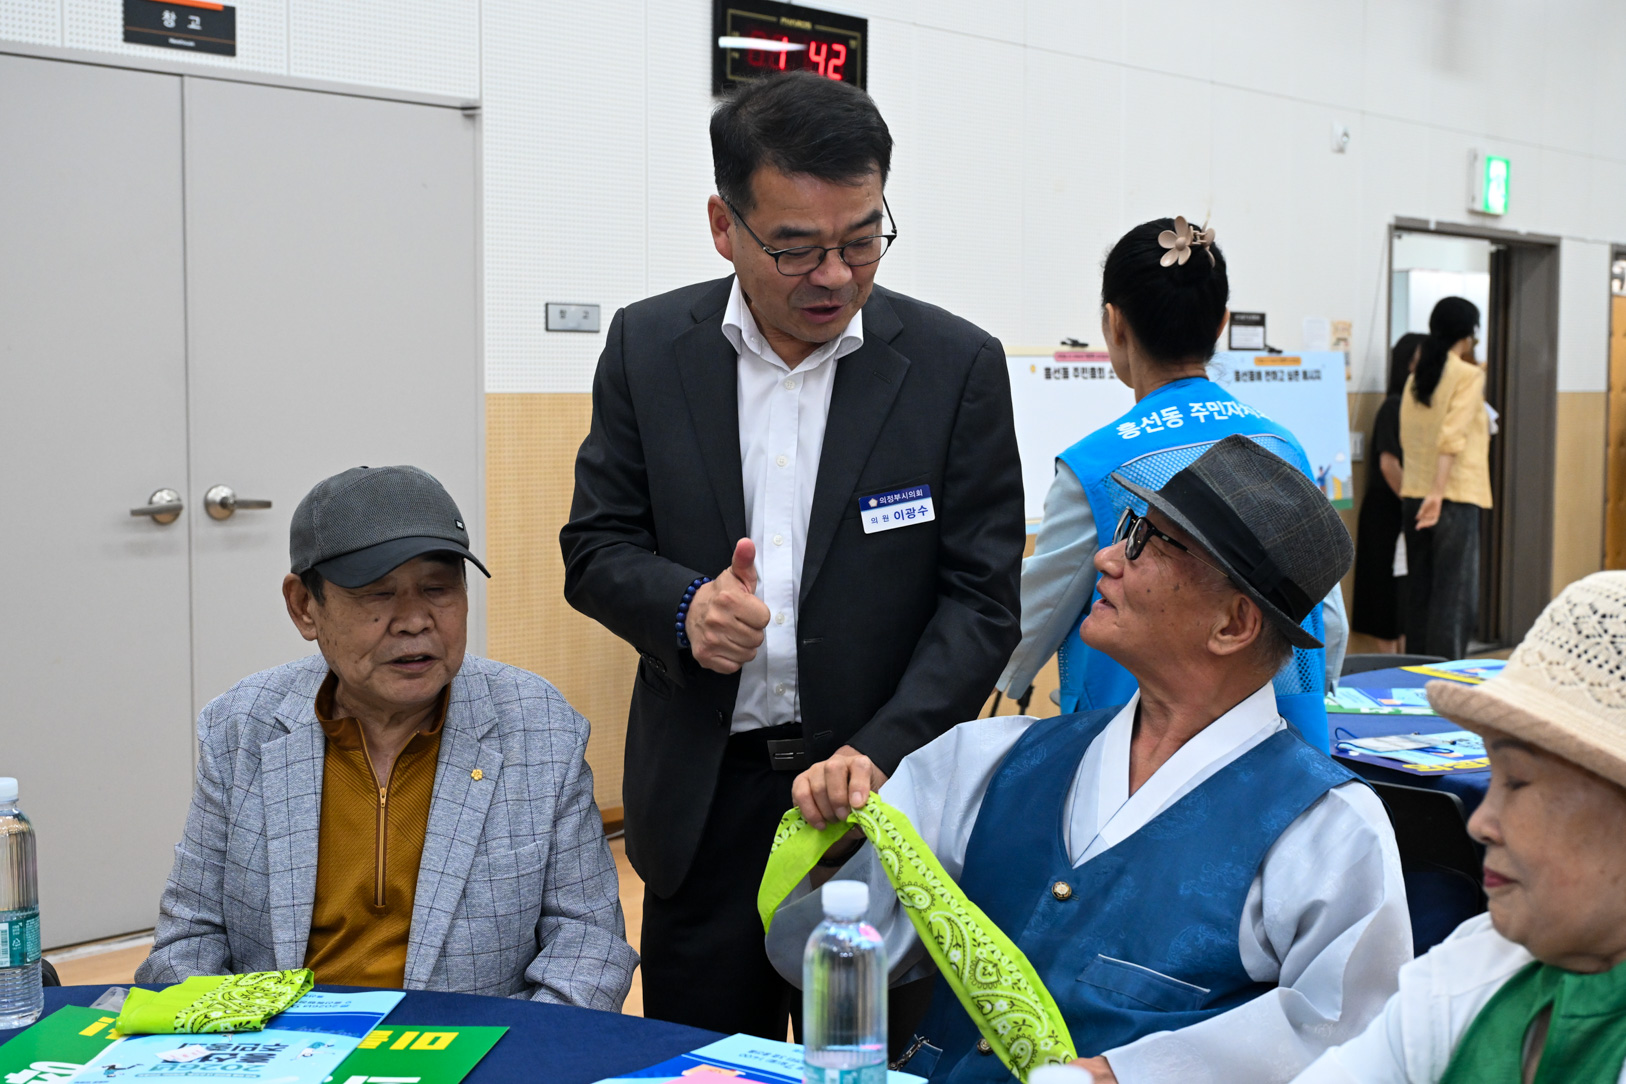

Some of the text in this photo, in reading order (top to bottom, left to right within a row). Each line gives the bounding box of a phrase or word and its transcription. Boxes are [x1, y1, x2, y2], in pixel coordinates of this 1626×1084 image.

[809, 41, 847, 81] 42
[1116, 406, 1184, 440] 흥선동
[879, 489, 923, 504] 의정부시의회
[894, 505, 928, 521] 이광수
[161, 1052, 277, 1063] 흥선
[149, 1063, 266, 1072] 2026년
